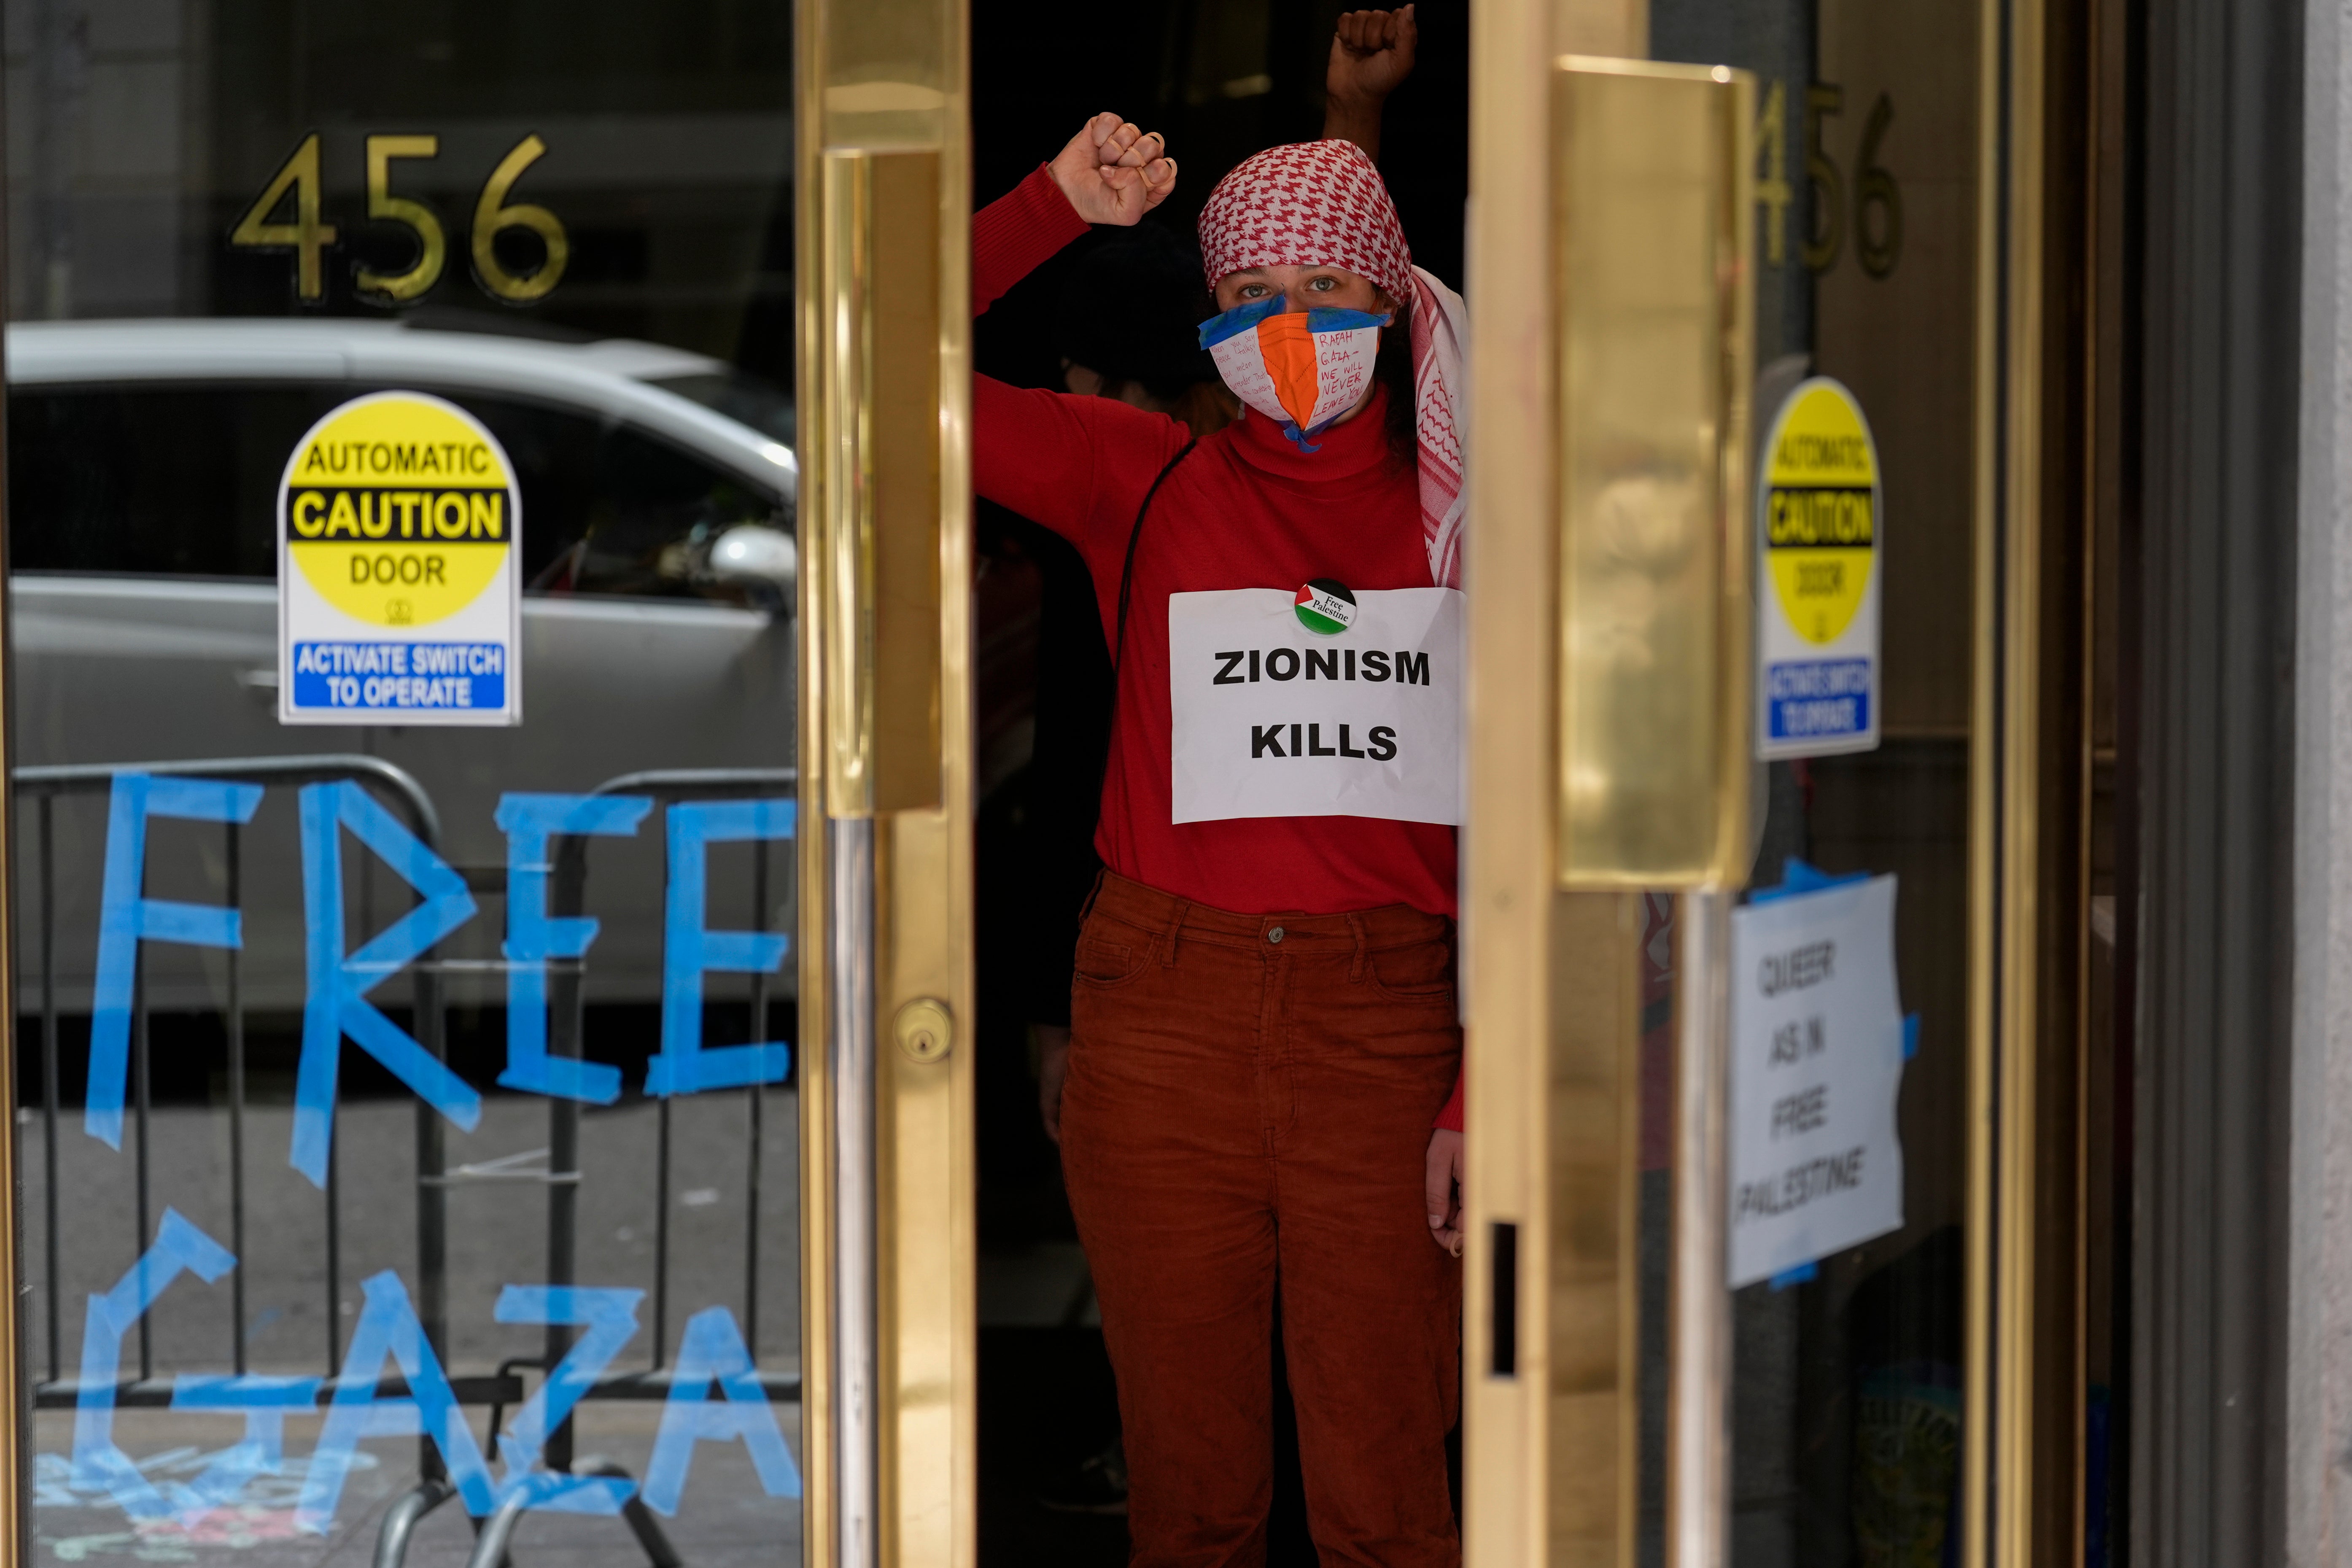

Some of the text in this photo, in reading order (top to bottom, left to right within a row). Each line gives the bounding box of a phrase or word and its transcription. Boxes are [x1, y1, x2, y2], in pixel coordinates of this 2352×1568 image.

[230, 132, 569, 302] 456
[1245, 334, 1255, 345] say
[1319, 330, 1352, 348] RAFAH
[1237, 361, 1253, 372] mean
[1321, 361, 1363, 380] WE WILL
[1322, 372, 1361, 398] NEVER
[1313, 393, 1347, 418] LEAVE
[305, 442, 490, 474] AUTOMATIC
[292, 490, 503, 539] CAUTION
[349, 554, 446, 585] DOOR
[1312, 599, 1348, 622] Palestine
[1325, 595, 1343, 610] Free
[297, 645, 502, 675] ACTIVATE SWITCH
[1213, 648, 1430, 686] ZIONISM
[326, 676, 472, 706] TO OPERATE
[1251, 723, 1397, 761] KILLS
[84, 771, 797, 1190] FREE
[70, 1205, 800, 1535] GAZA
